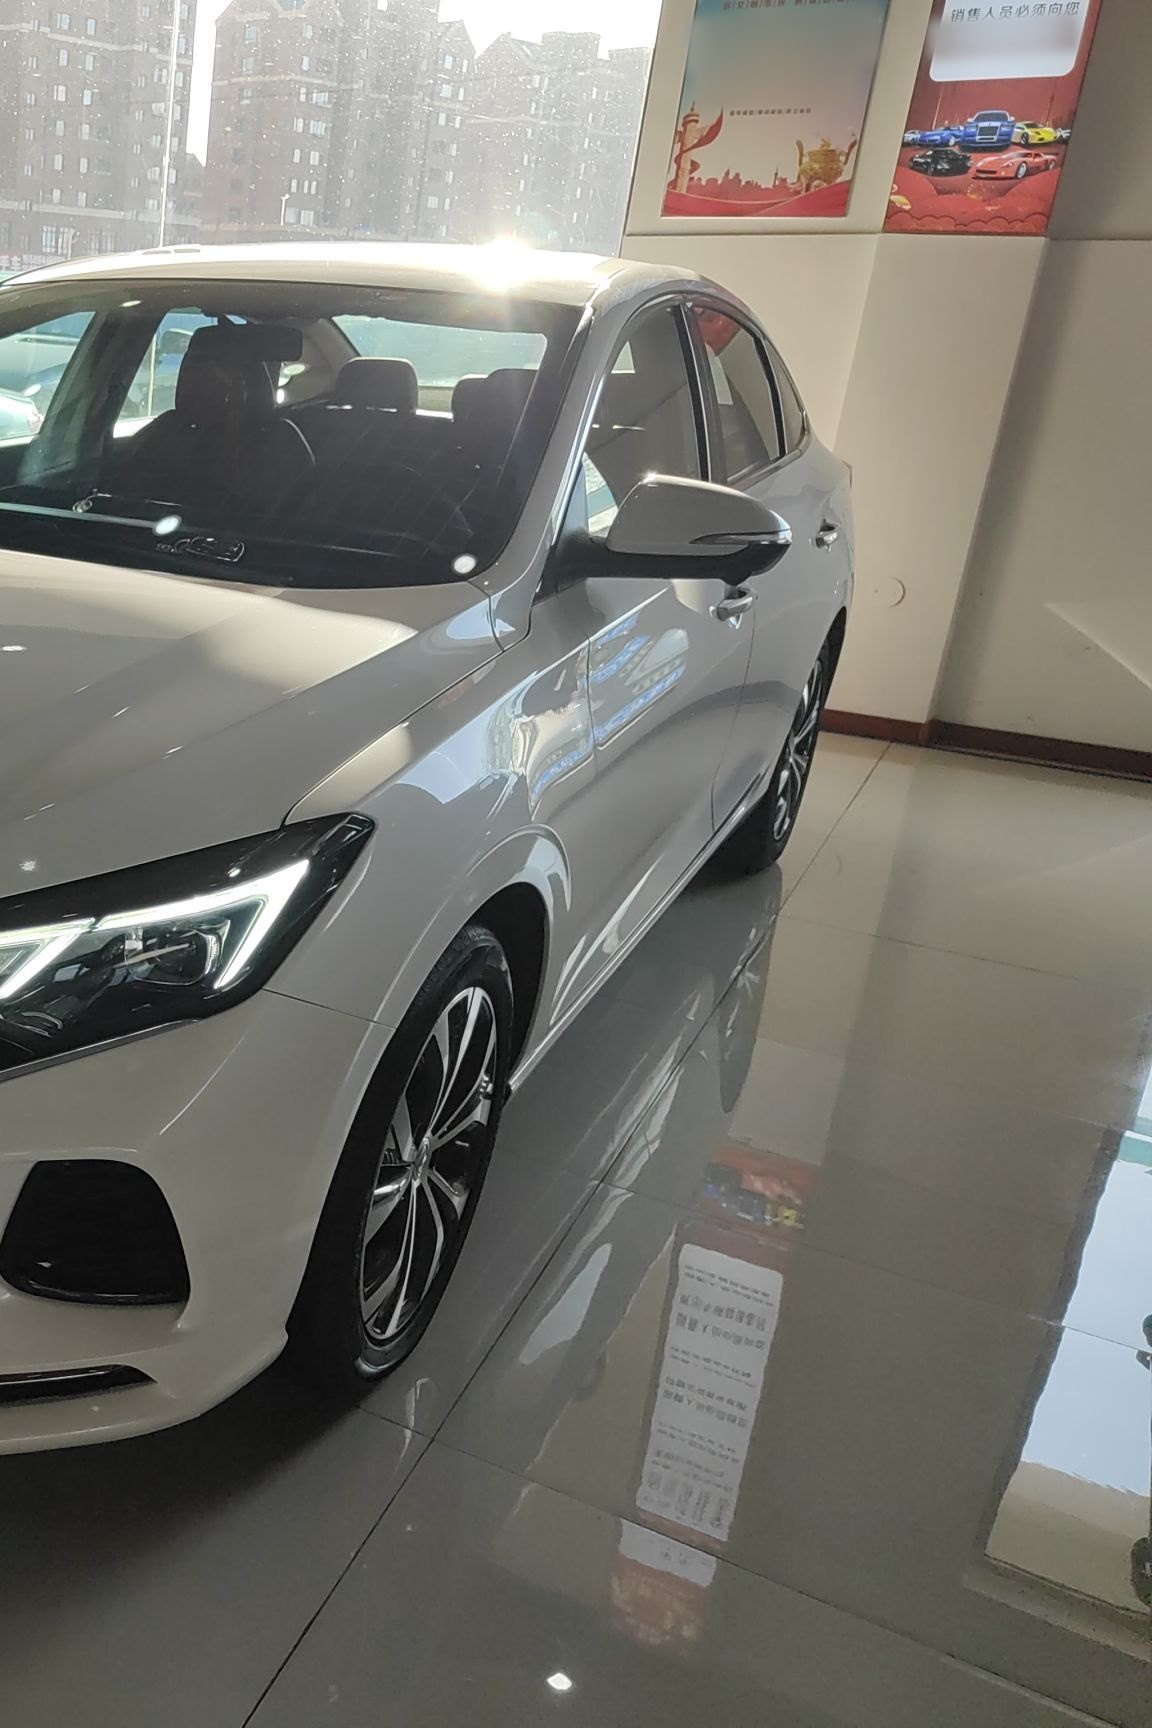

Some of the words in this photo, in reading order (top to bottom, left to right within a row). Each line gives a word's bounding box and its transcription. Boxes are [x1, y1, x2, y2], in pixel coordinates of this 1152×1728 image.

[950, 1, 1081, 23] 销售人员必须向您
